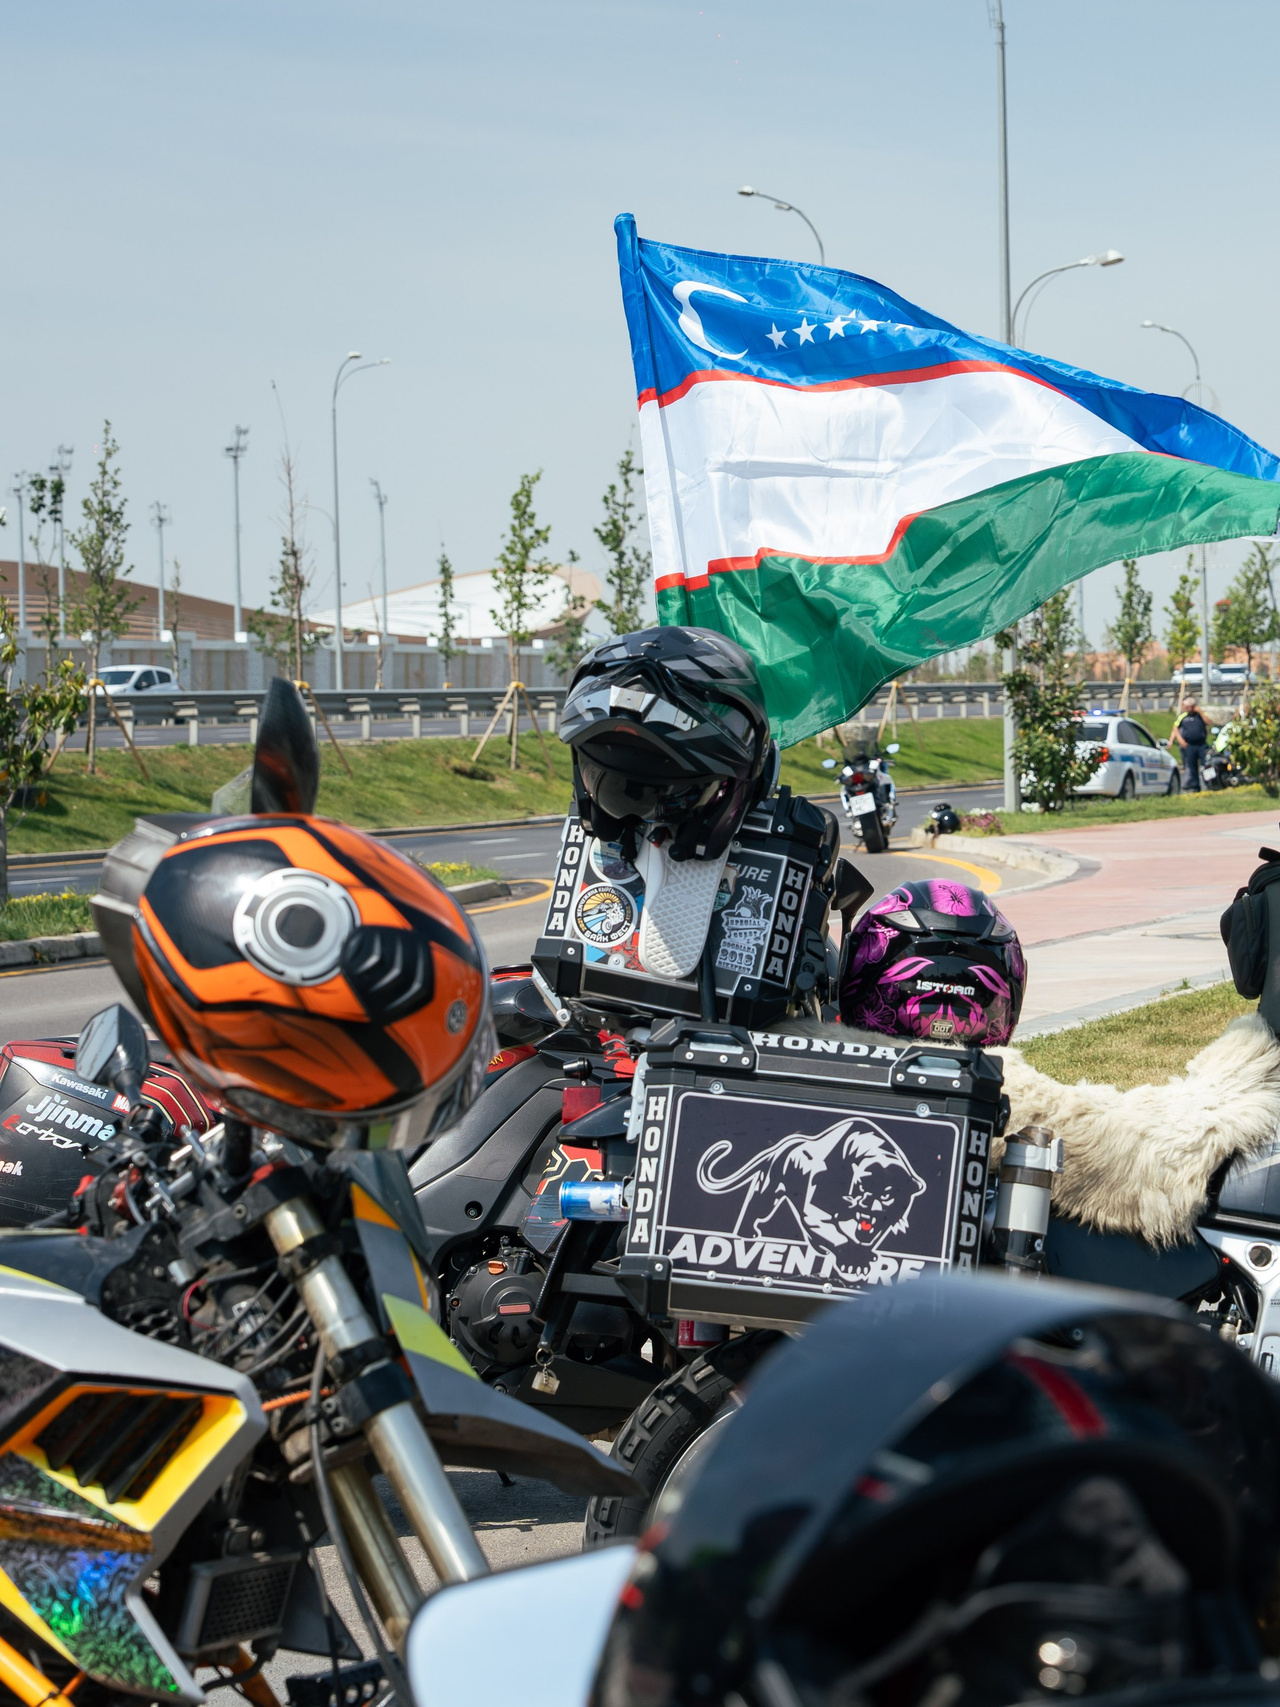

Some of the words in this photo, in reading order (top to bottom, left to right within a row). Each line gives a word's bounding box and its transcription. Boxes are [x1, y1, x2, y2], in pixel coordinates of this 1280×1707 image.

[548, 825, 585, 930] HONDA
[766, 868, 805, 977] HONDA
[51, 1072, 110, 1100] Kawasaki
[751, 1032, 900, 1061] HONDA
[630, 1096, 667, 1243] HONDA
[956, 1129, 989, 1277] HONDA
[669, 1233, 926, 1287] ADVENTRE
